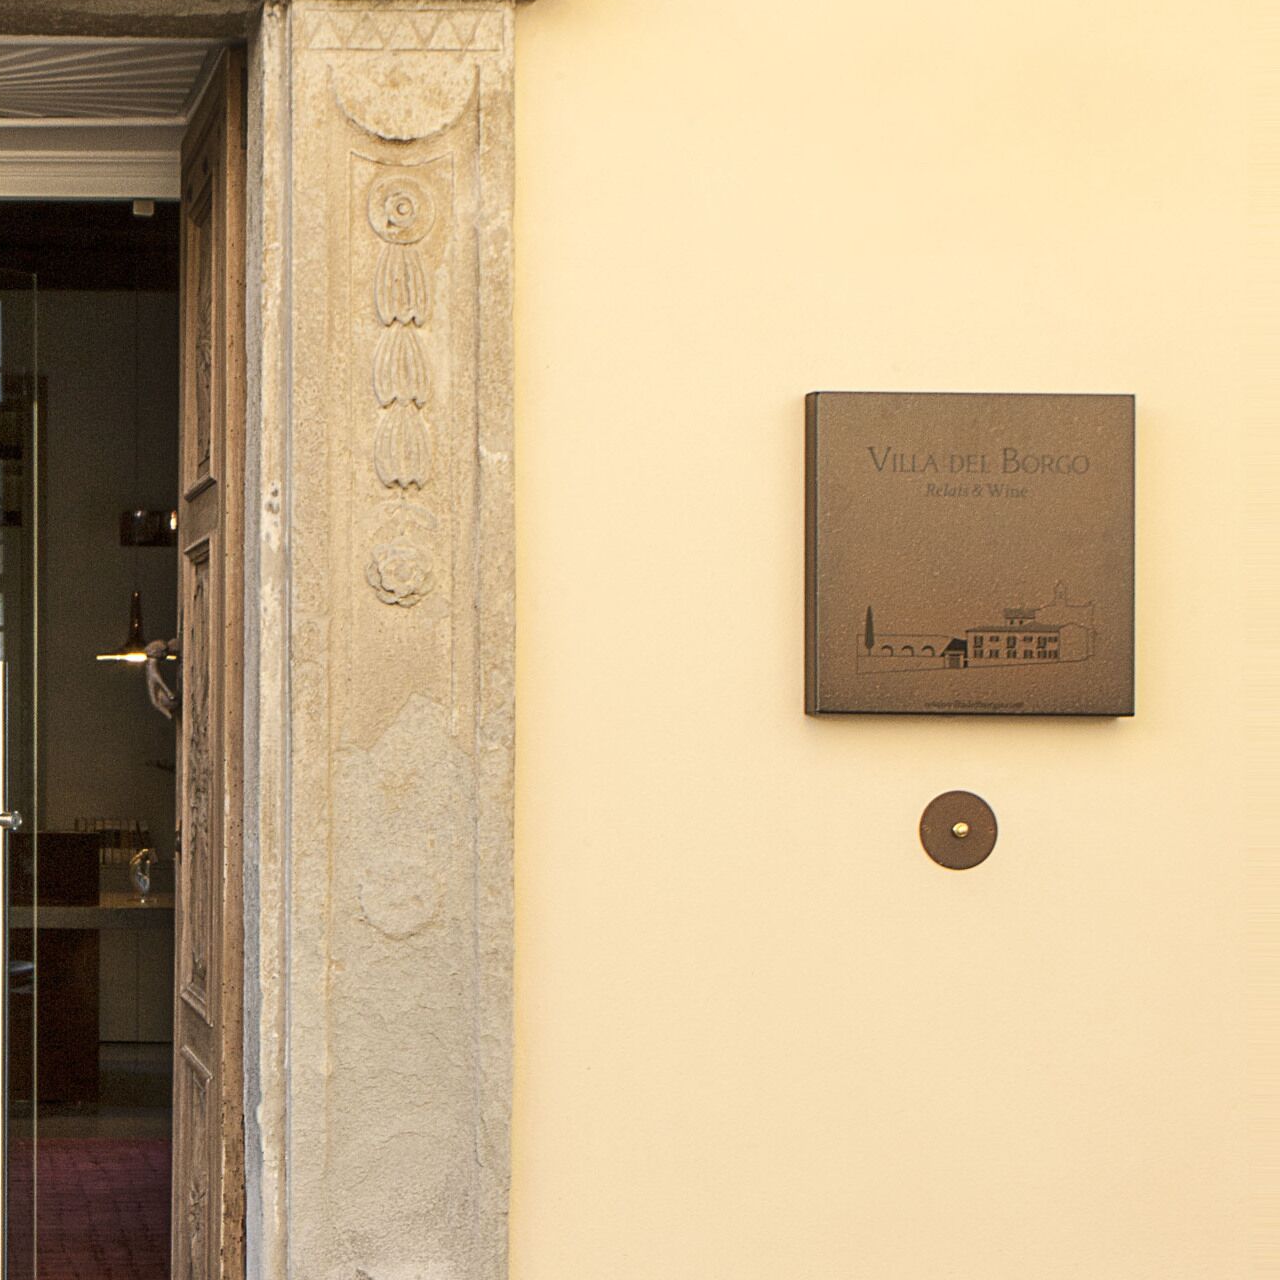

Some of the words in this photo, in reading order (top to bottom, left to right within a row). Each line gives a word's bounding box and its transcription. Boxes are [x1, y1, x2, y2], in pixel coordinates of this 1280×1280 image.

[867, 446, 940, 473] VILLA
[950, 453, 991, 473] DEL
[1001, 446, 1090, 475] BORGO
[926, 483, 968, 498] Relais
[973, 484, 985, 497] &
[989, 483, 1029, 498] Wine
